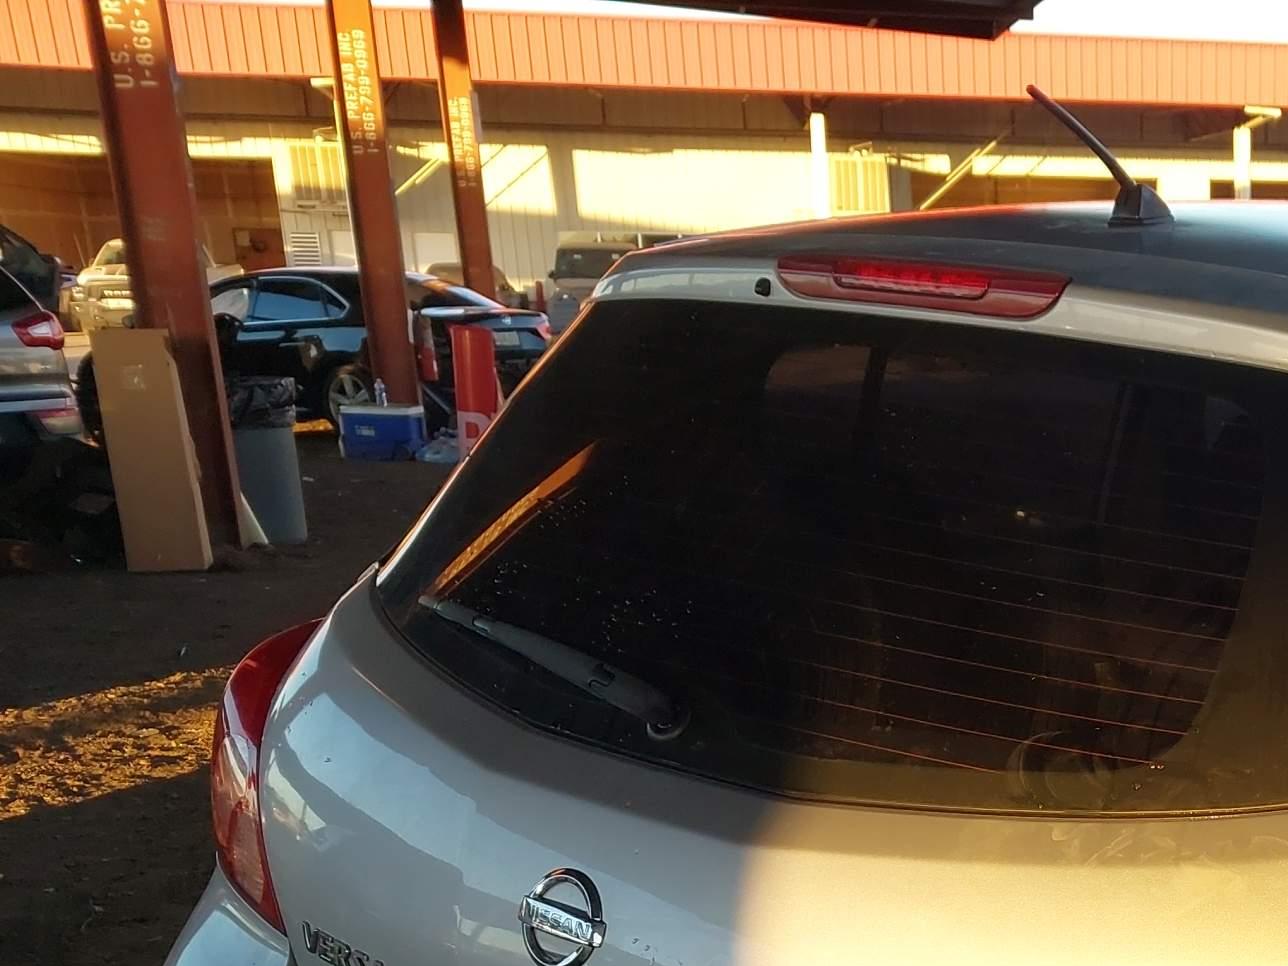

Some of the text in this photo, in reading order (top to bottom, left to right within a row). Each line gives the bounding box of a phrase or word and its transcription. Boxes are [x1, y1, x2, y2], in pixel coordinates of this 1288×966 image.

[110, 43, 135, 89] U.S.
[341, 63, 361, 119] PREFAB
[522, 897, 593, 942] NISSAN
